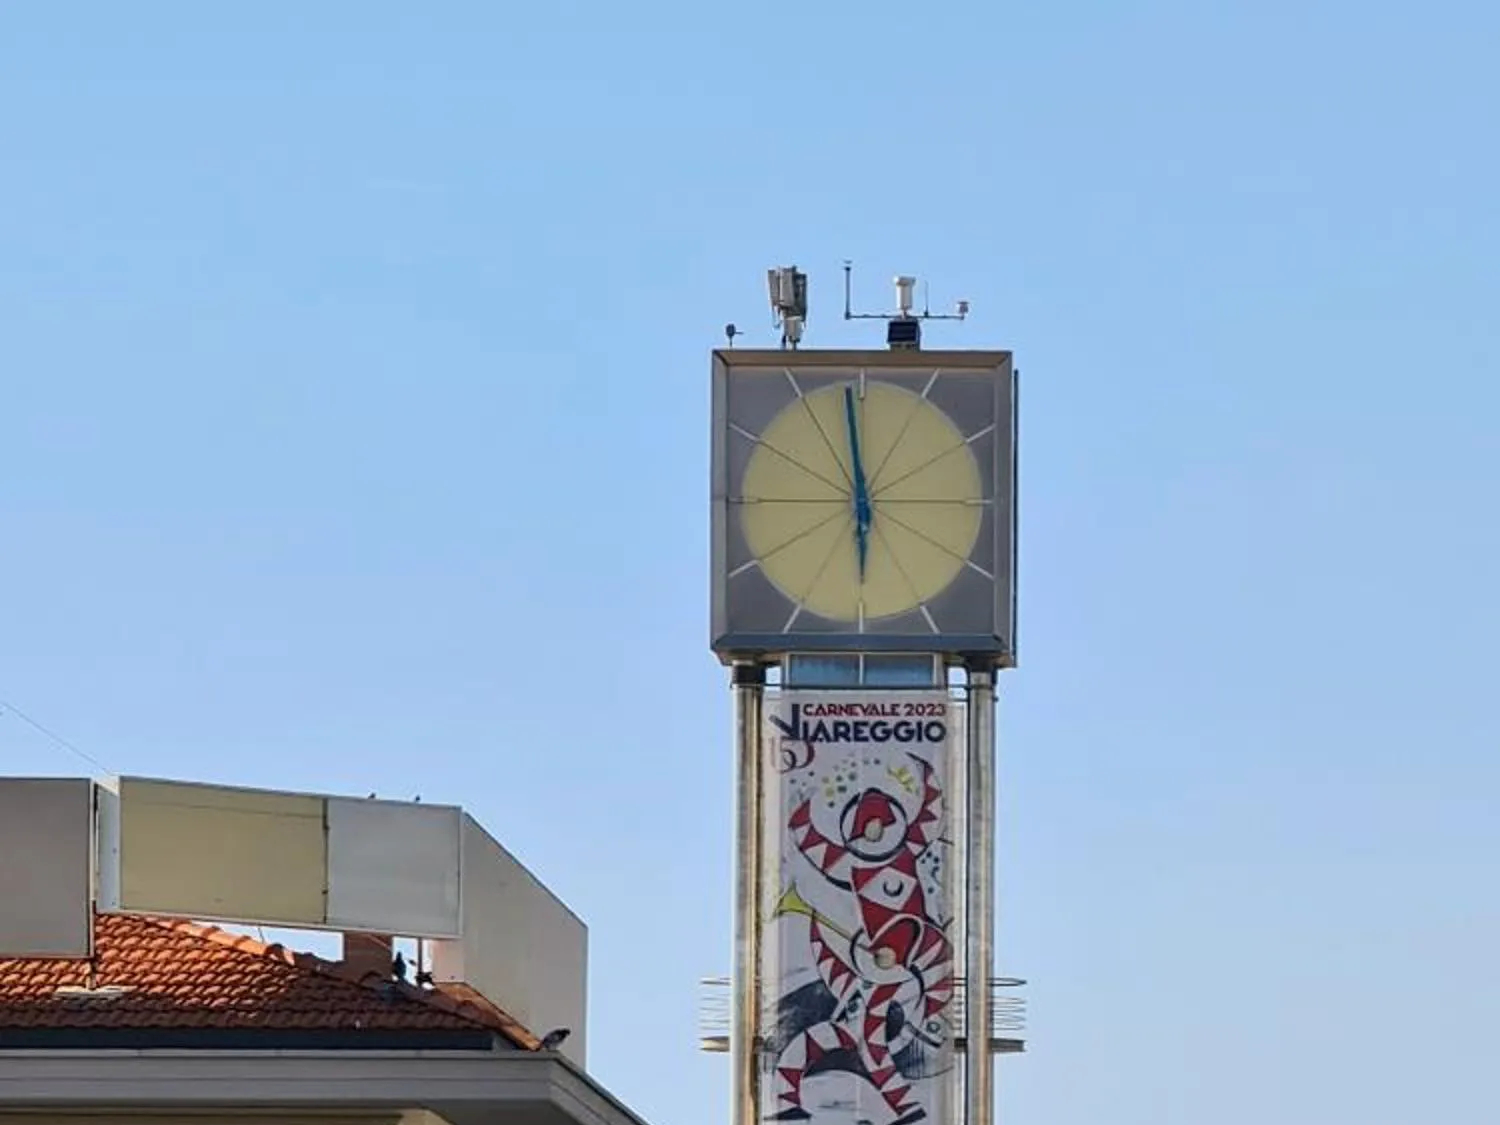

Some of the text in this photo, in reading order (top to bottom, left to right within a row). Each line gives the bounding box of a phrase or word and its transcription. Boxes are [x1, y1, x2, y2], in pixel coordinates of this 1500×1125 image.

[768, 703, 947, 743] VIAREGGIO
[803, 703, 947, 717] CARNEVALE 2023
